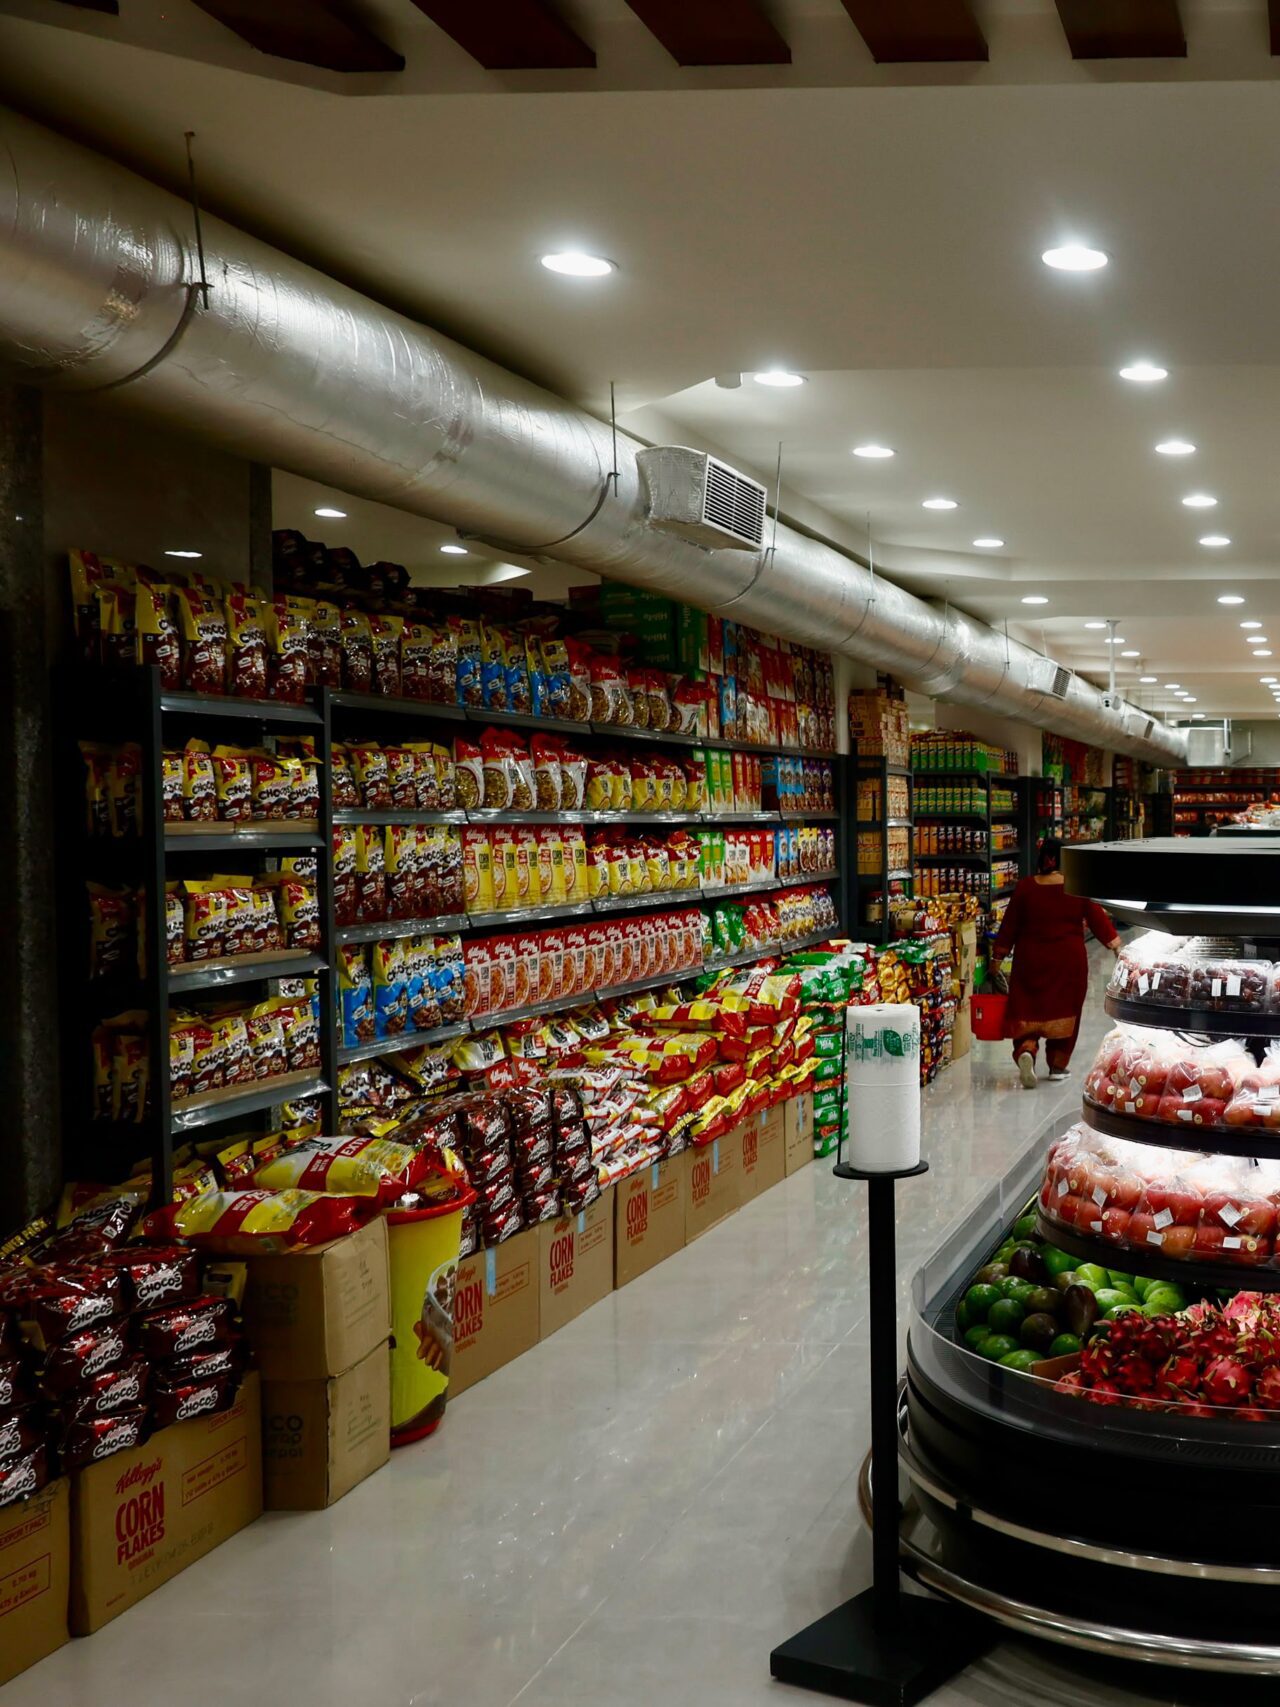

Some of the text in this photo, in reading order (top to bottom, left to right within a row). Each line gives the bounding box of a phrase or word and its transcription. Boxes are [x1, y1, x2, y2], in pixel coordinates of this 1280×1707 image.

[225, 912, 255, 929] CHOCO
[289, 1025, 320, 1045] CHOCO
[340, 1136, 371, 1156] EXTR
[626, 1189, 648, 1226] CORN
[626, 1217, 648, 1241] FLAKES
[549, 1232, 574, 1272] CORN
[138, 1272, 182, 1300] CHOCOS
[550, 1262, 574, 1289] FLAKES
[67, 1297, 113, 1331] CHOCOS
[454, 1279, 483, 1325] ORN
[175, 1324, 216, 1352] CHOCOS
[454, 1314, 483, 1344] LAKES
[82, 1340, 123, 1378] CHOCOS
[97, 1380, 139, 1410] CHOCOS
[178, 1391, 219, 1420] CHOCOS
[94, 1429, 138, 1458] CHOCOS
[0, 1469, 37, 1503] HOCOS
[116, 1457, 162, 1495] Kellogg's
[116, 1481, 165, 1543] CORN
[117, 1520, 165, 1566] FLAKES
